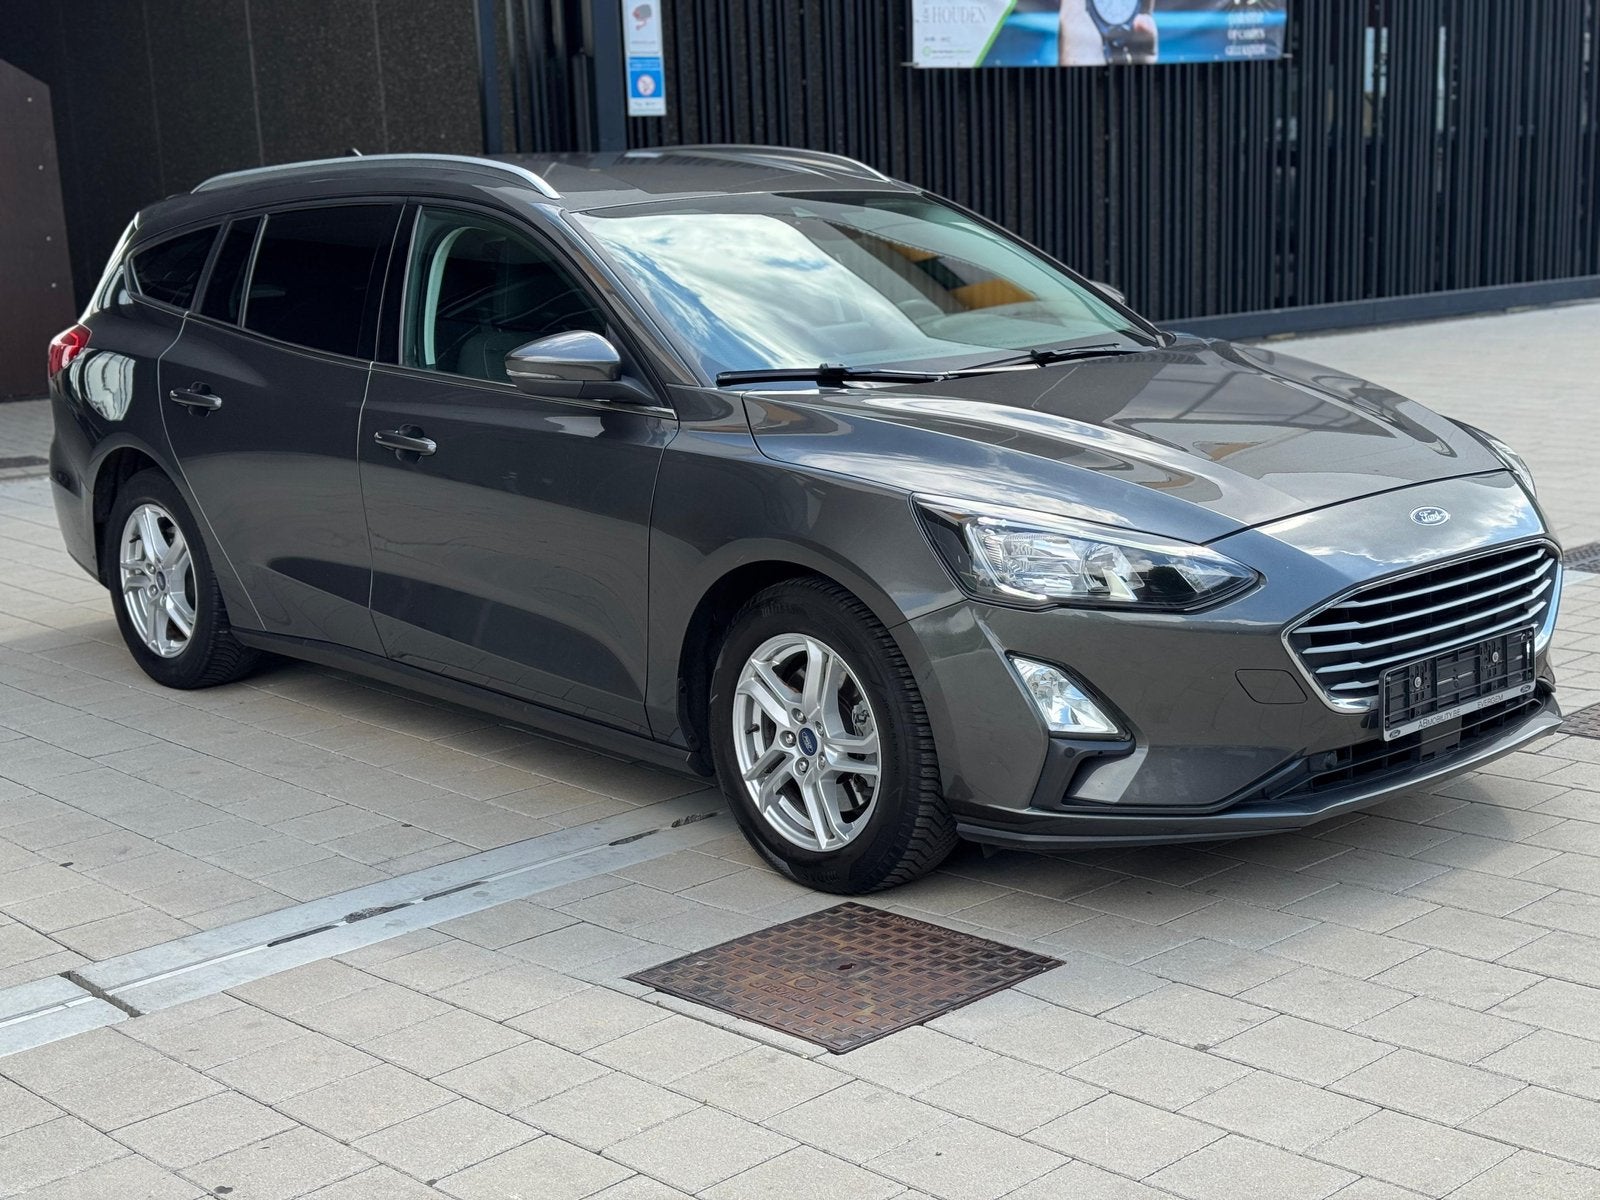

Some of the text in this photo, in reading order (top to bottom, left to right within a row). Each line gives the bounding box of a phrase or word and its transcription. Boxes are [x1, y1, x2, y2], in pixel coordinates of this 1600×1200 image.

[931, 5, 987, 24] HOUDEN
[1416, 508, 1446, 523] Ford
[1477, 694, 1504, 709] EVERGEM
[800, 730, 815, 754] Ford
